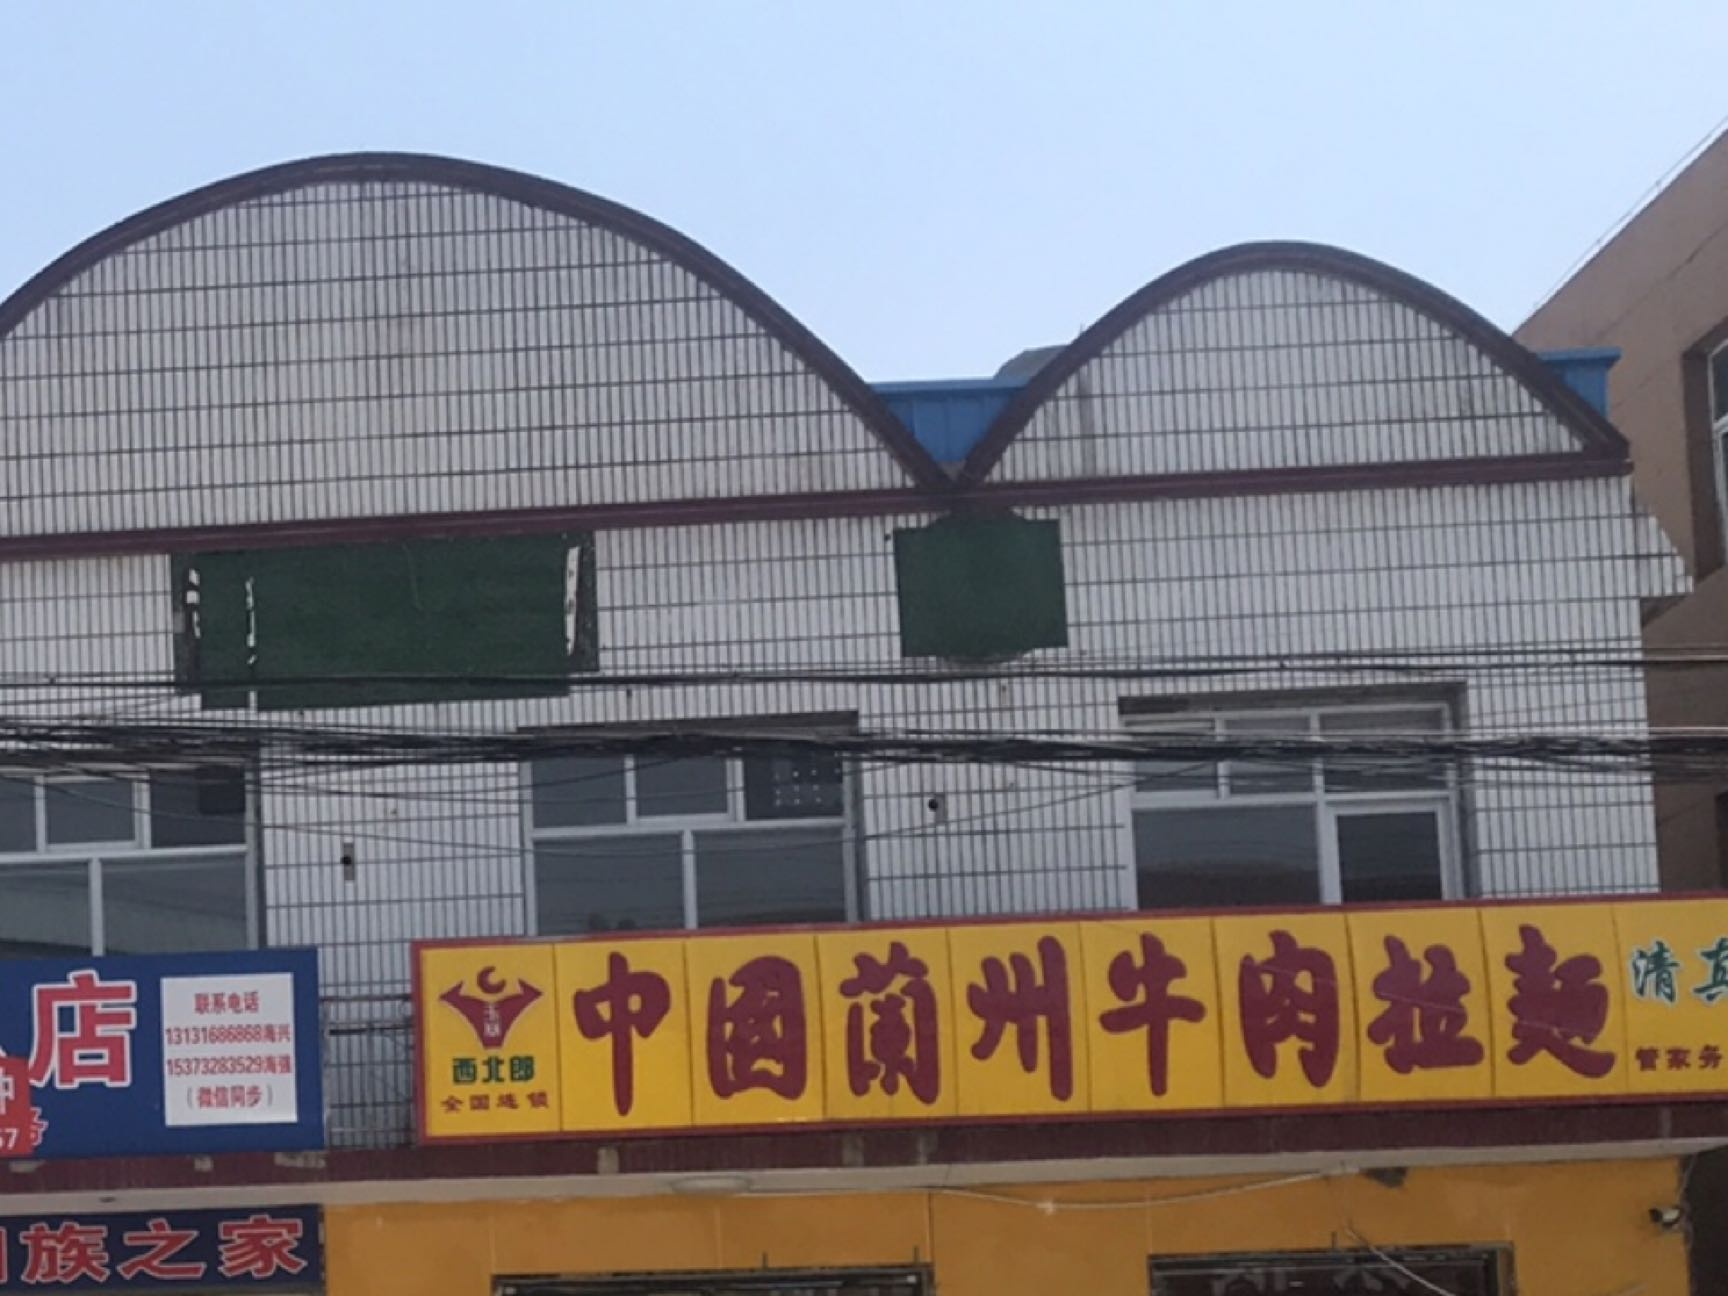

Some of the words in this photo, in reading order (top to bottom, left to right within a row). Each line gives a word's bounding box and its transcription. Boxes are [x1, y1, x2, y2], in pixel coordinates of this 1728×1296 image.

[194, 990, 260, 1015] 联系电话
[1635, 1044, 1723, 1072] 管家务
